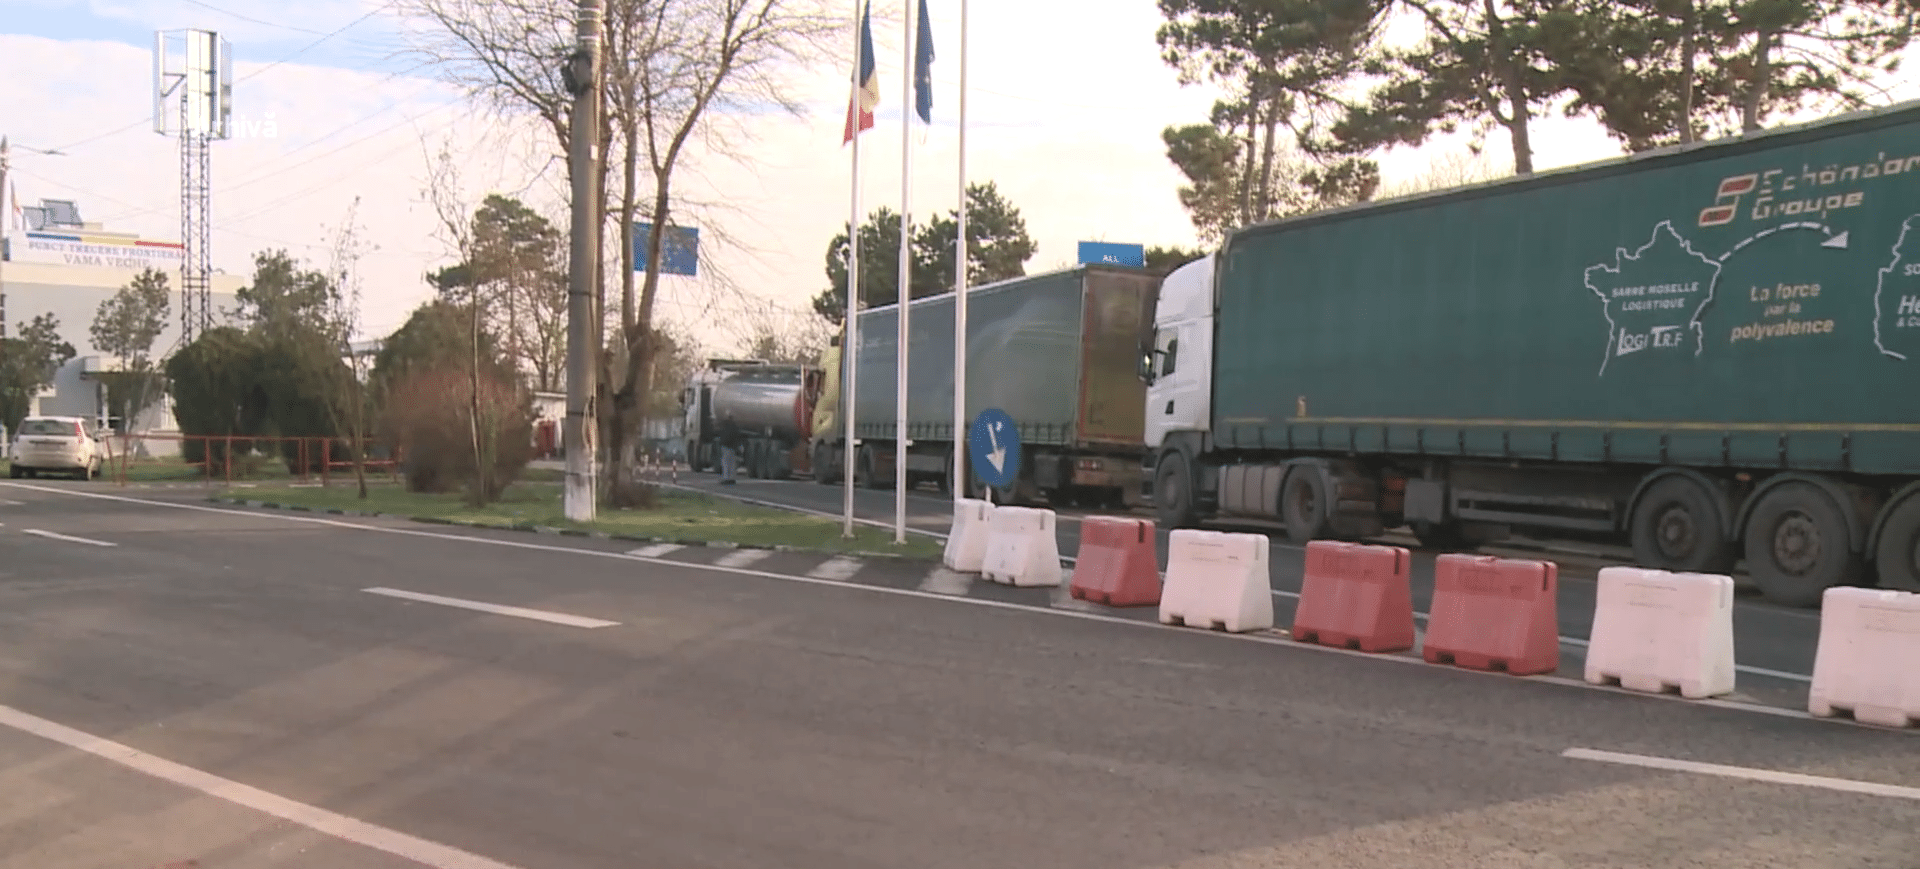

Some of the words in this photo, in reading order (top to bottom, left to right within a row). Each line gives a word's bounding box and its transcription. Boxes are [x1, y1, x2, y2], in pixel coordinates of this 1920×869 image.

[1752, 192, 1864, 220] Groupe
[69, 244, 119, 256] TRECERE
[63, 253, 102, 266] VAMA
[106, 257, 150, 269] VECHE
[1611, 286, 1647, 298] SARRE
[1648, 281, 1699, 294] MOSELLE
[1750, 285, 1770, 302] La
[1776, 282, 1821, 300] force
[1622, 297, 1685, 311] LOGISTIQUE
[1729, 318, 1835, 344] polyvalence
